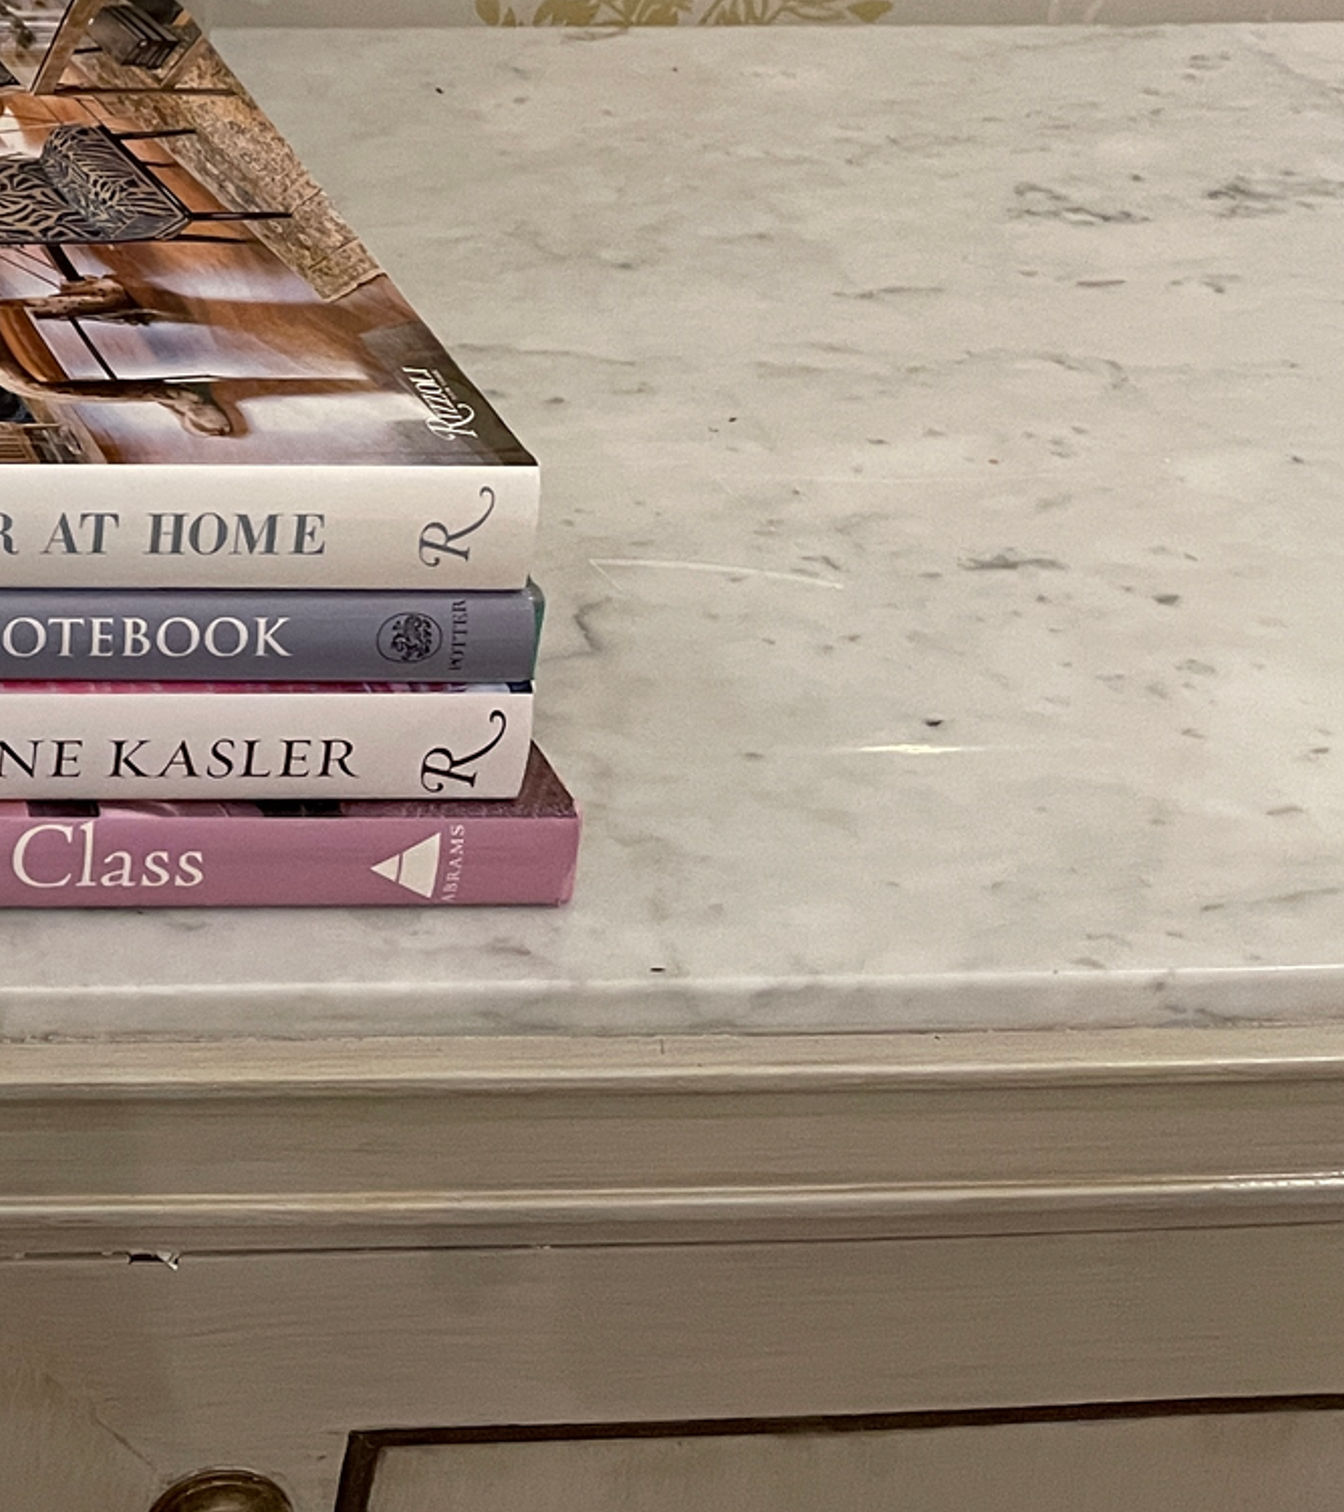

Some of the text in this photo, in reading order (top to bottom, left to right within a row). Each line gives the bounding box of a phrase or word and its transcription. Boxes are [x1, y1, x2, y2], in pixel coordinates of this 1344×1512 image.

[43, 512, 121, 556] AT
[146, 511, 327, 556] HOME
[448, 599, 468, 670] POTTER
[109, 738, 360, 780] KASLER
[10, 822, 205, 889] Class
[441, 823, 466, 902] ABRAMS
